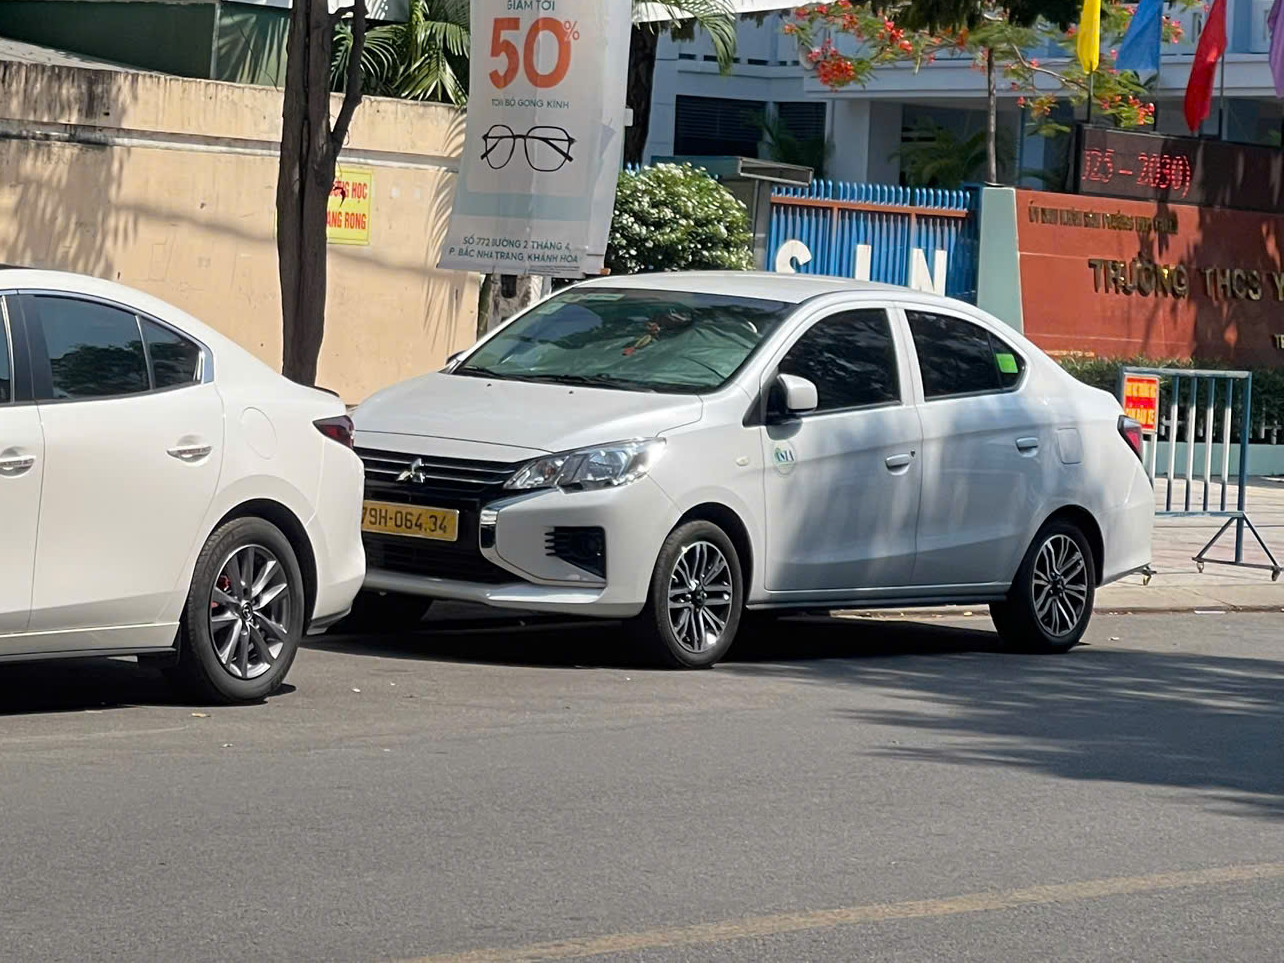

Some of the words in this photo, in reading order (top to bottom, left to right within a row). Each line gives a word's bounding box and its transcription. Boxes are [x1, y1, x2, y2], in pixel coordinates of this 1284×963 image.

[352, 182, 368, 203] HỌC
[344, 211, 367, 230] RONG
[476, 237, 491, 246] 772
[523, 240, 529, 249] 2
[531, 238, 562, 251] THÁNG
[527, 252, 558, 263] KHÁNH
[1203, 266, 1262, 301] THCS
[361, 506, 447, 534] 79H-064.34
